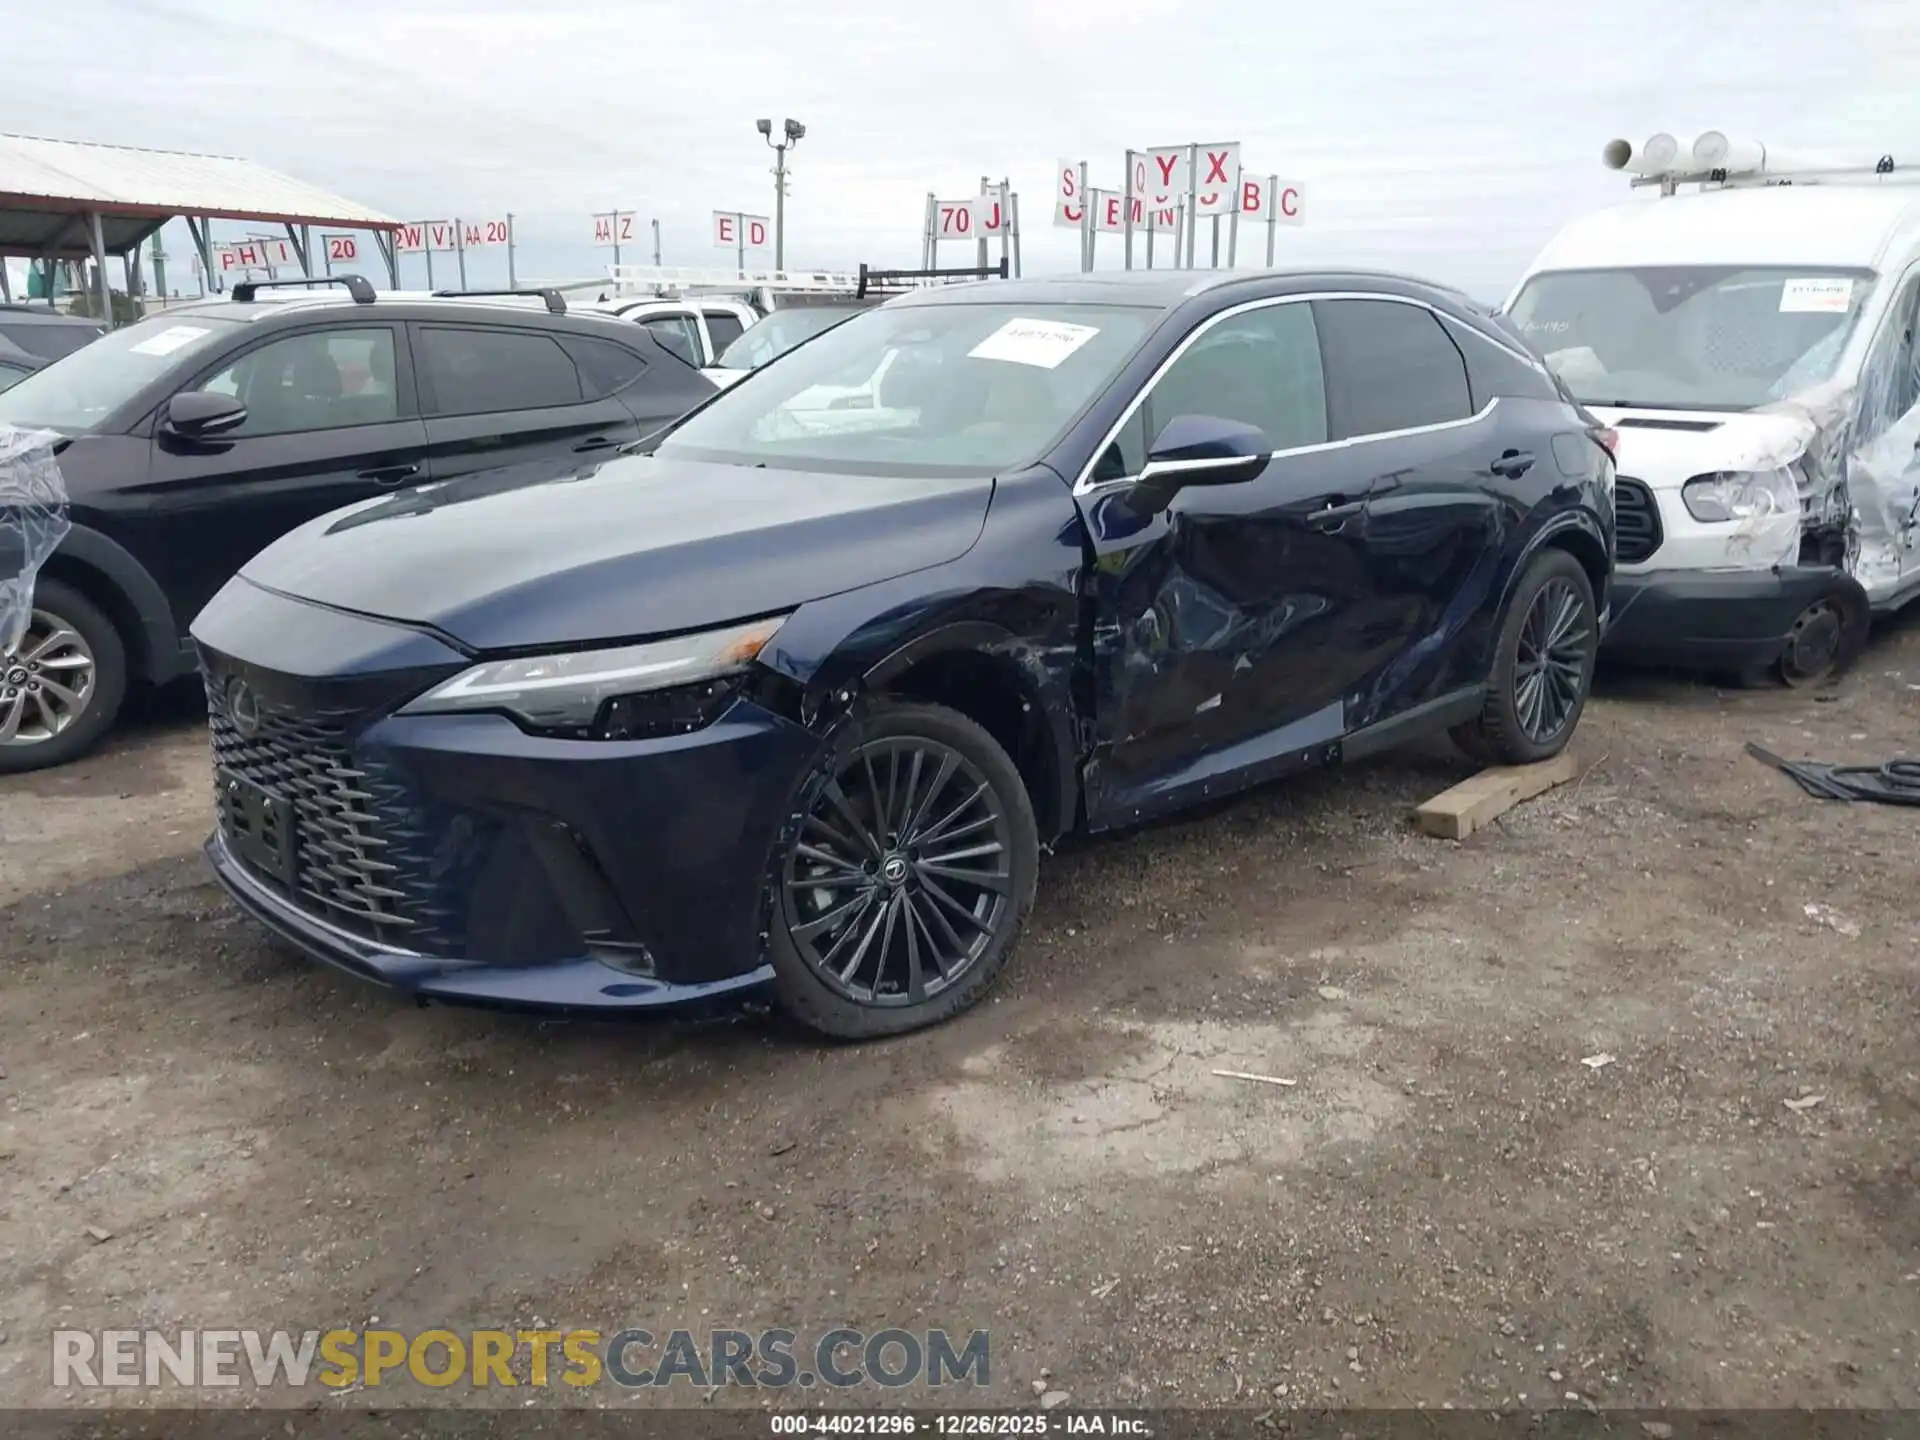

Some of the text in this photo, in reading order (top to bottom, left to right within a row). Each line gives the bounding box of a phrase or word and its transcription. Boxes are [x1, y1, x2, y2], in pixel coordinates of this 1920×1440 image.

[1136, 161, 1145, 193] Q
[1156, 154, 1178, 186] Y
[1205, 151, 1229, 184] X
[1063, 168, 1074, 197] S
[1243, 182, 1260, 211] B
[1281, 188, 1298, 216] C
[941, 207, 969, 233] 70
[985, 201, 1000, 229] J
[1107, 198, 1119, 225] E
[432, 226, 444, 246] V
[465, 226, 481, 246] AA
[487, 221, 507, 242] 20
[595, 218, 611, 241] AA
[621, 218, 633, 240] Z
[720, 218, 733, 242] E
[751, 222, 765, 245] D
[239, 246, 257, 265] H
[331, 239, 356, 259] 20
[222, 253, 235, 270] P
